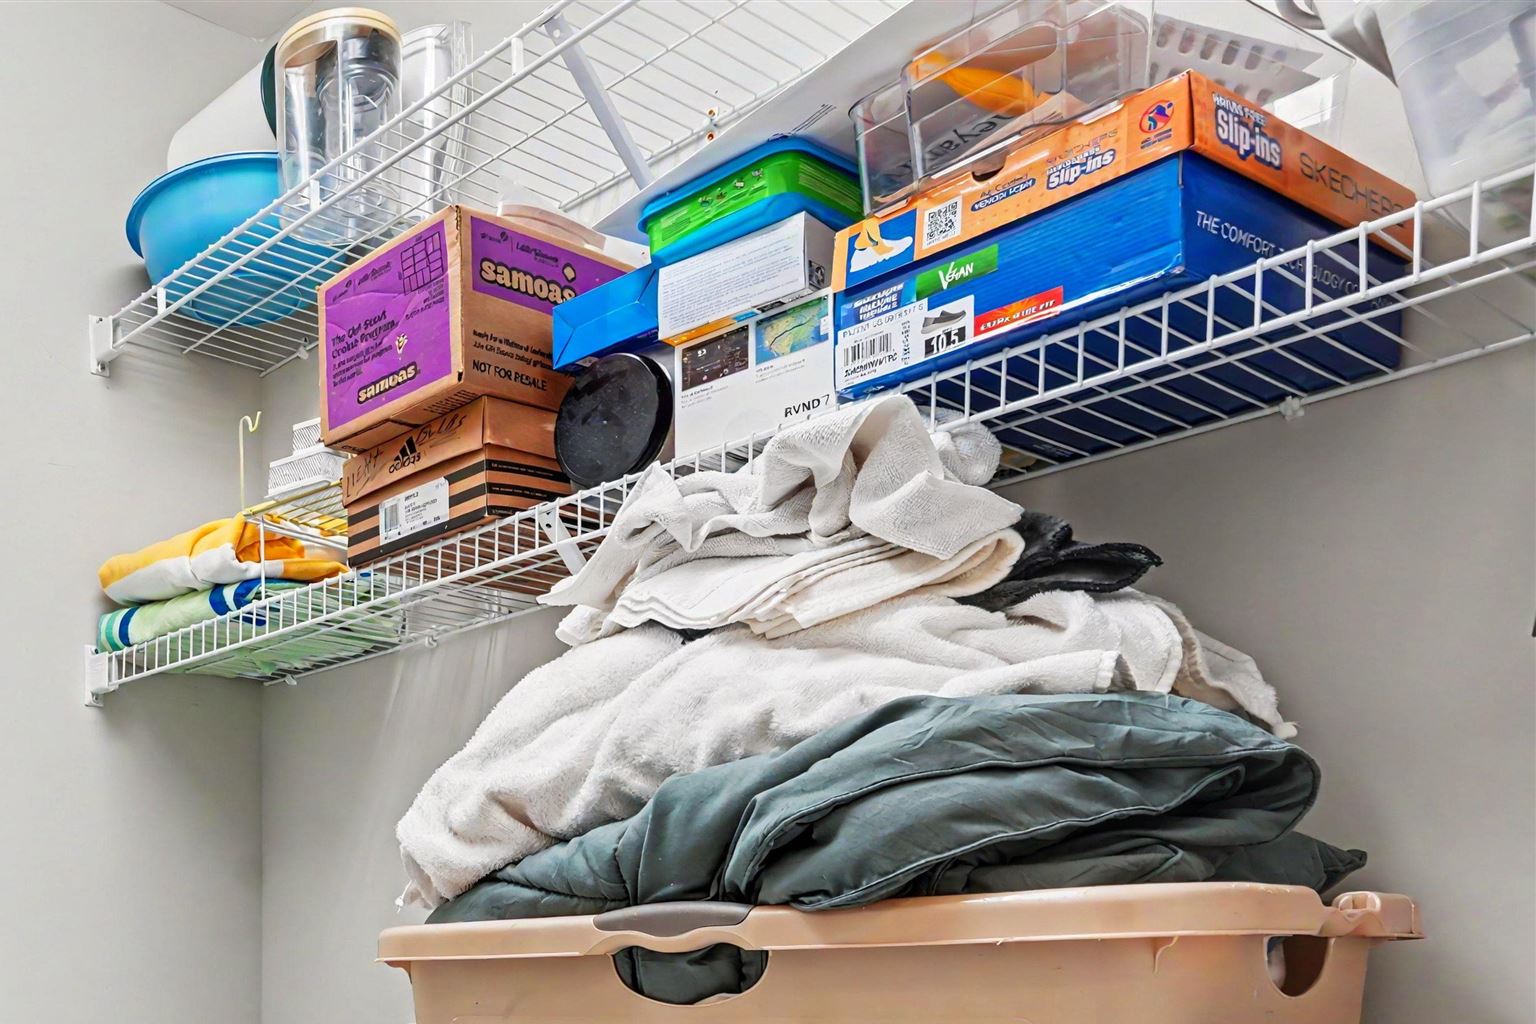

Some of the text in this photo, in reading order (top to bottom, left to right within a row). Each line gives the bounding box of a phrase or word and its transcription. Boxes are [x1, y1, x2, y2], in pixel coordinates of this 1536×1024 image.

[1217, 109, 1281, 167] Slip-ins
[1048, 151, 1116, 189] Slip-ins
[1197, 210, 1345, 291] THE COMFORT CHOLOGY
[472, 359, 548, 392] NOT FOR RESALE
[784, 398, 821, 418] RVND
